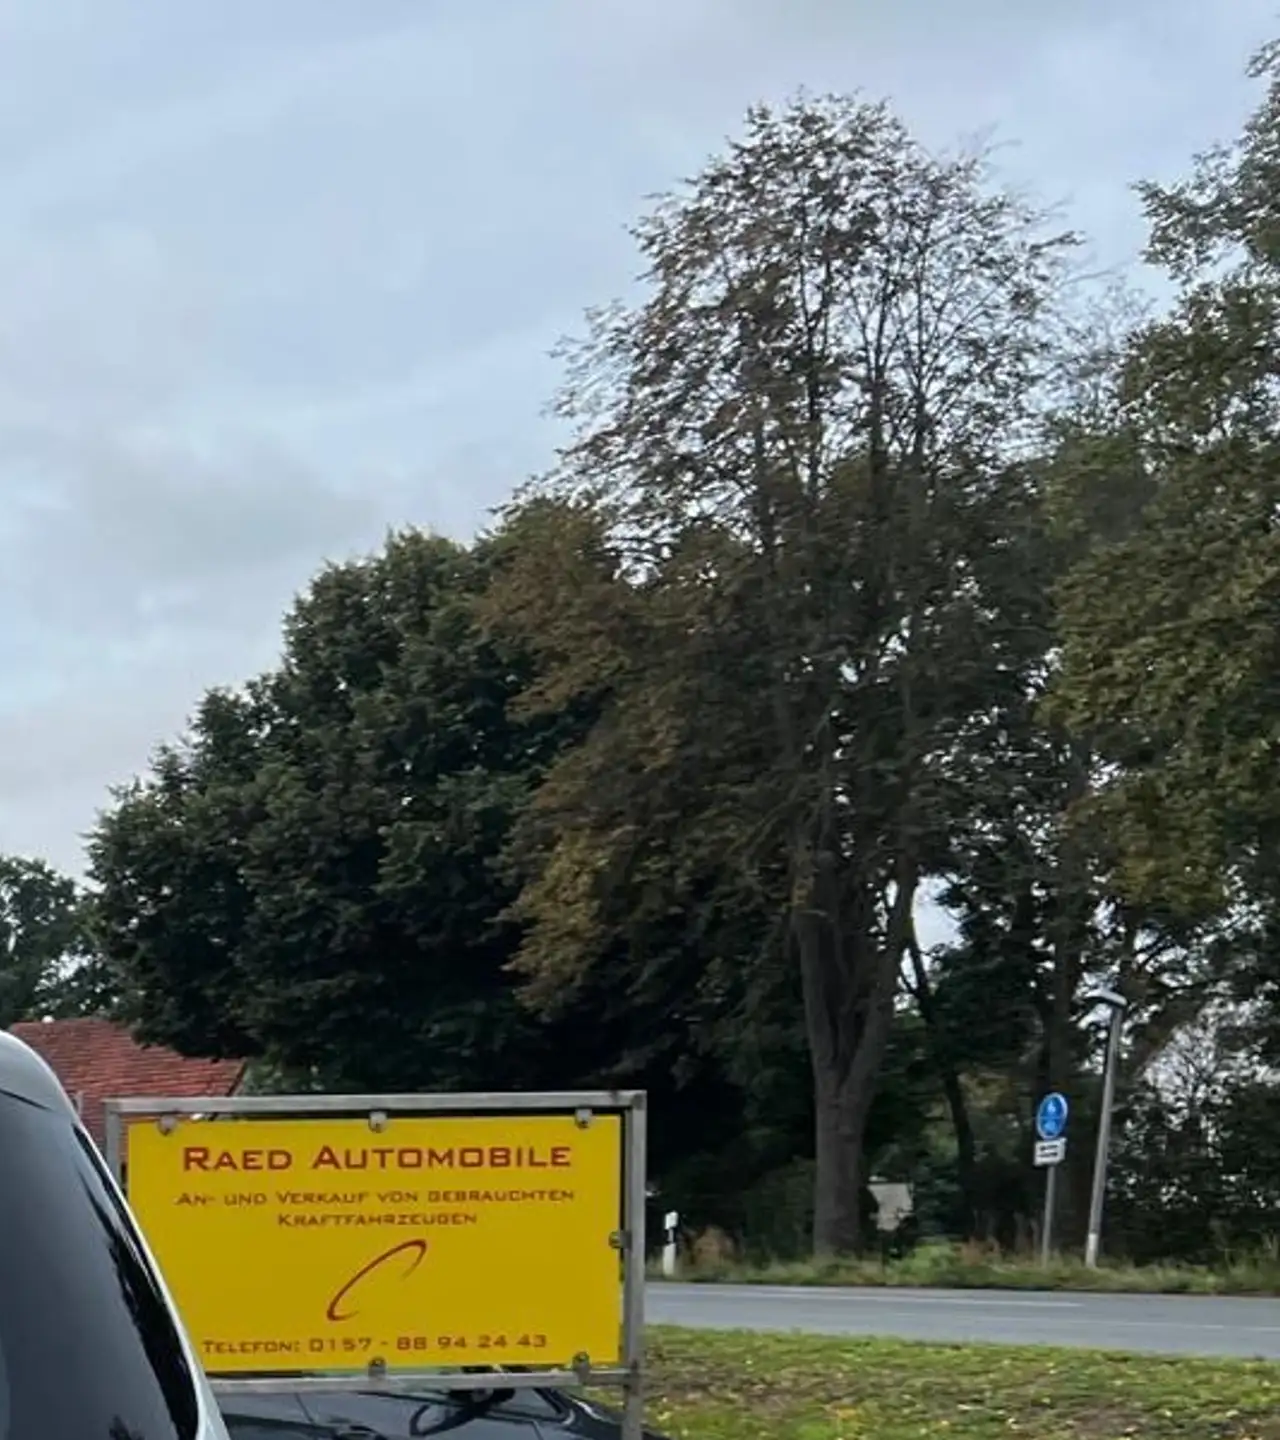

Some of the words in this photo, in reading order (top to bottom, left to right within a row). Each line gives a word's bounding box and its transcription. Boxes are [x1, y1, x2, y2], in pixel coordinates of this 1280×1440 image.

[183, 1146, 293, 1171] RAED
[312, 1145, 571, 1171] AUTOMOBILE
[309, 1338, 372, 1353] 0157
[396, 1336, 428, 1350] 88
[437, 1336, 467, 1349] 94
[477, 1334, 508, 1349] 24
[516, 1334, 547, 1348] 43
